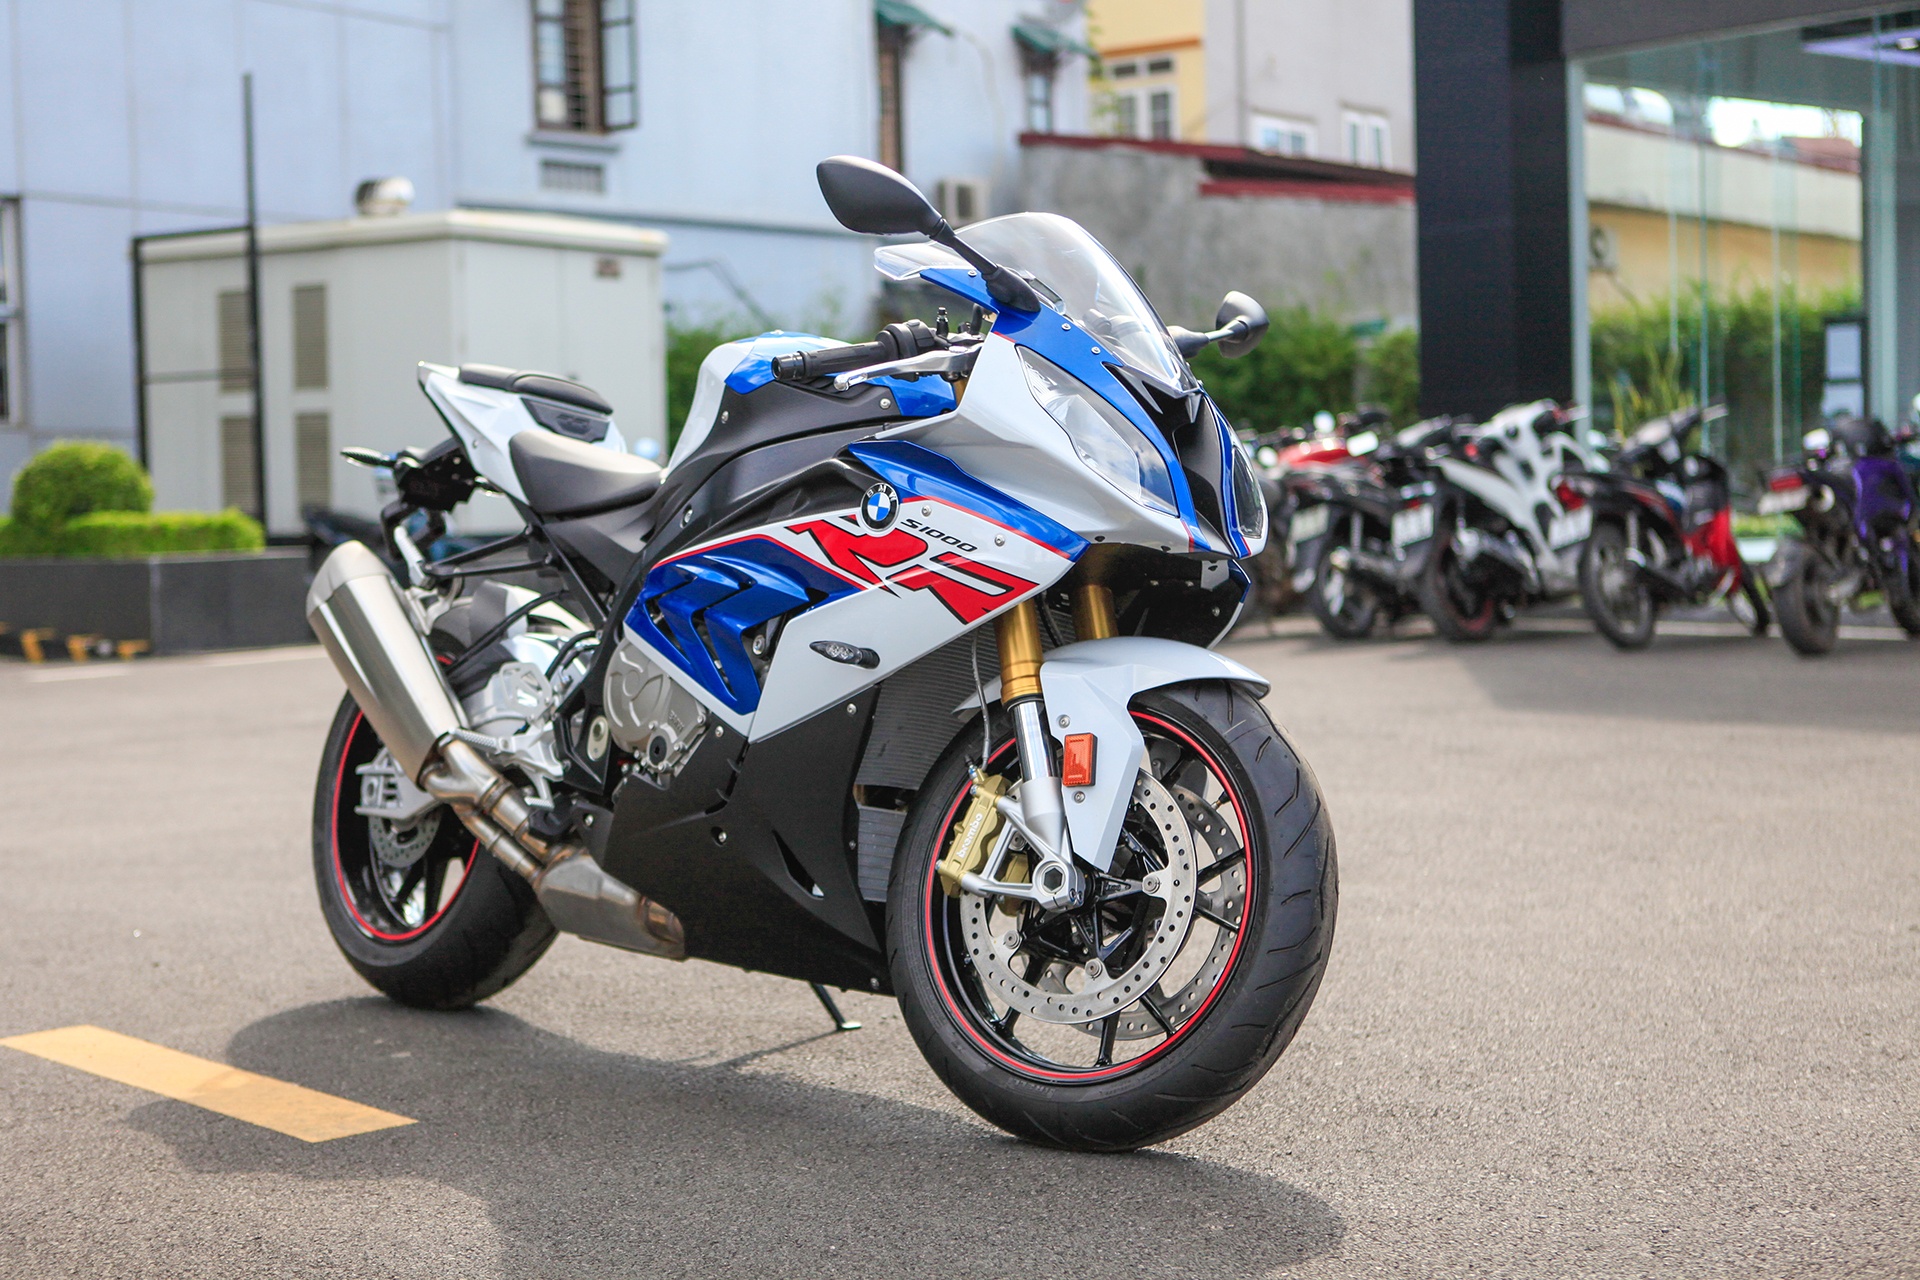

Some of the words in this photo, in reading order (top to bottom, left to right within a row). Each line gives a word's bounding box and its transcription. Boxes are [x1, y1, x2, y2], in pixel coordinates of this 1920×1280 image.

[866, 484, 897, 501] BMW
[900, 518, 978, 552] S1000
[956, 813, 983, 859] brembo
